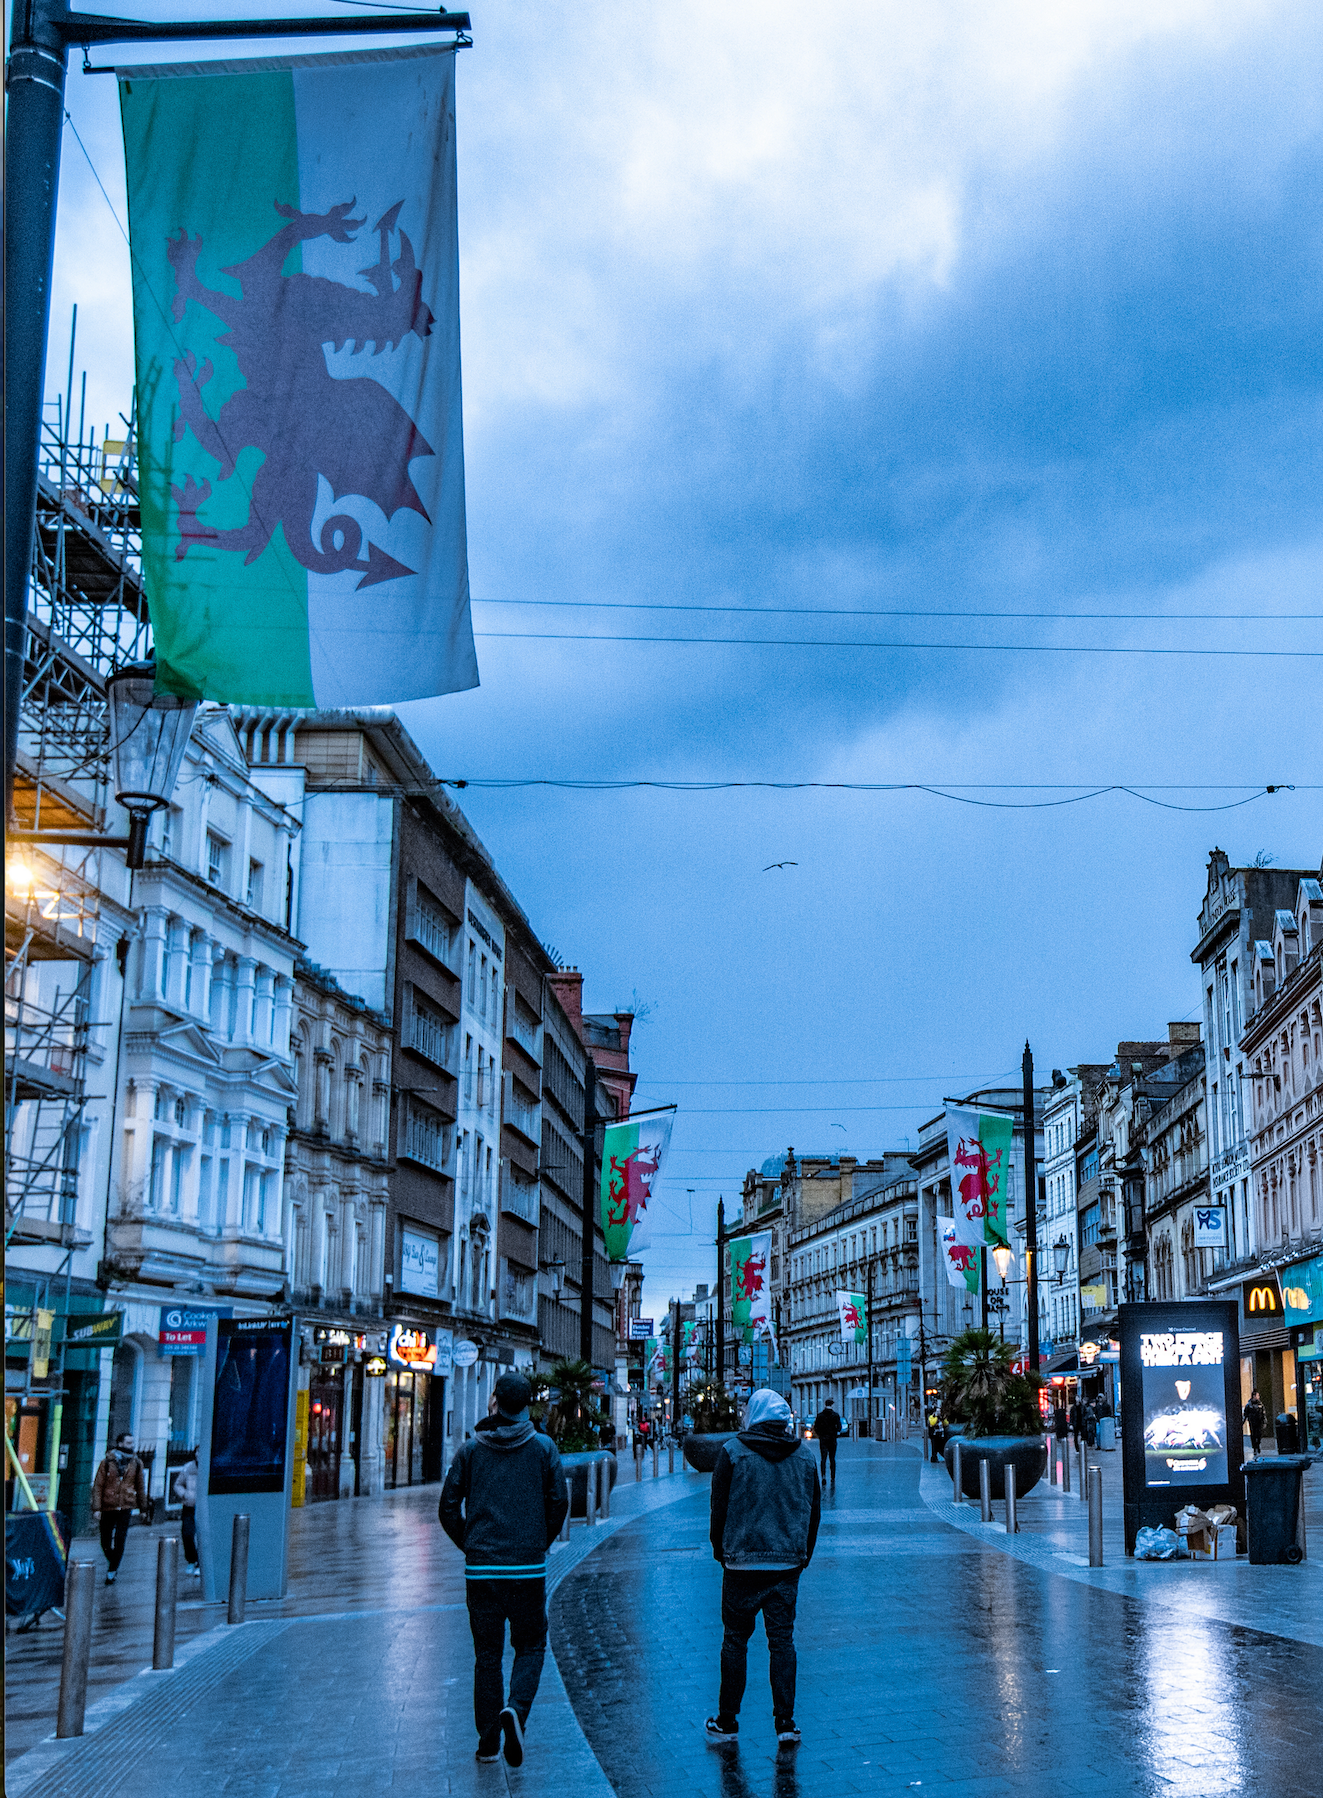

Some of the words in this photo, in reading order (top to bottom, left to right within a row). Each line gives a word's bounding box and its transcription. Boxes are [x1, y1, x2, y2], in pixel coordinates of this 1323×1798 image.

[72, 1316, 117, 1340] SUBWAY
[165, 1333, 176, 1341] To
[177, 1333, 192, 1341] Let
